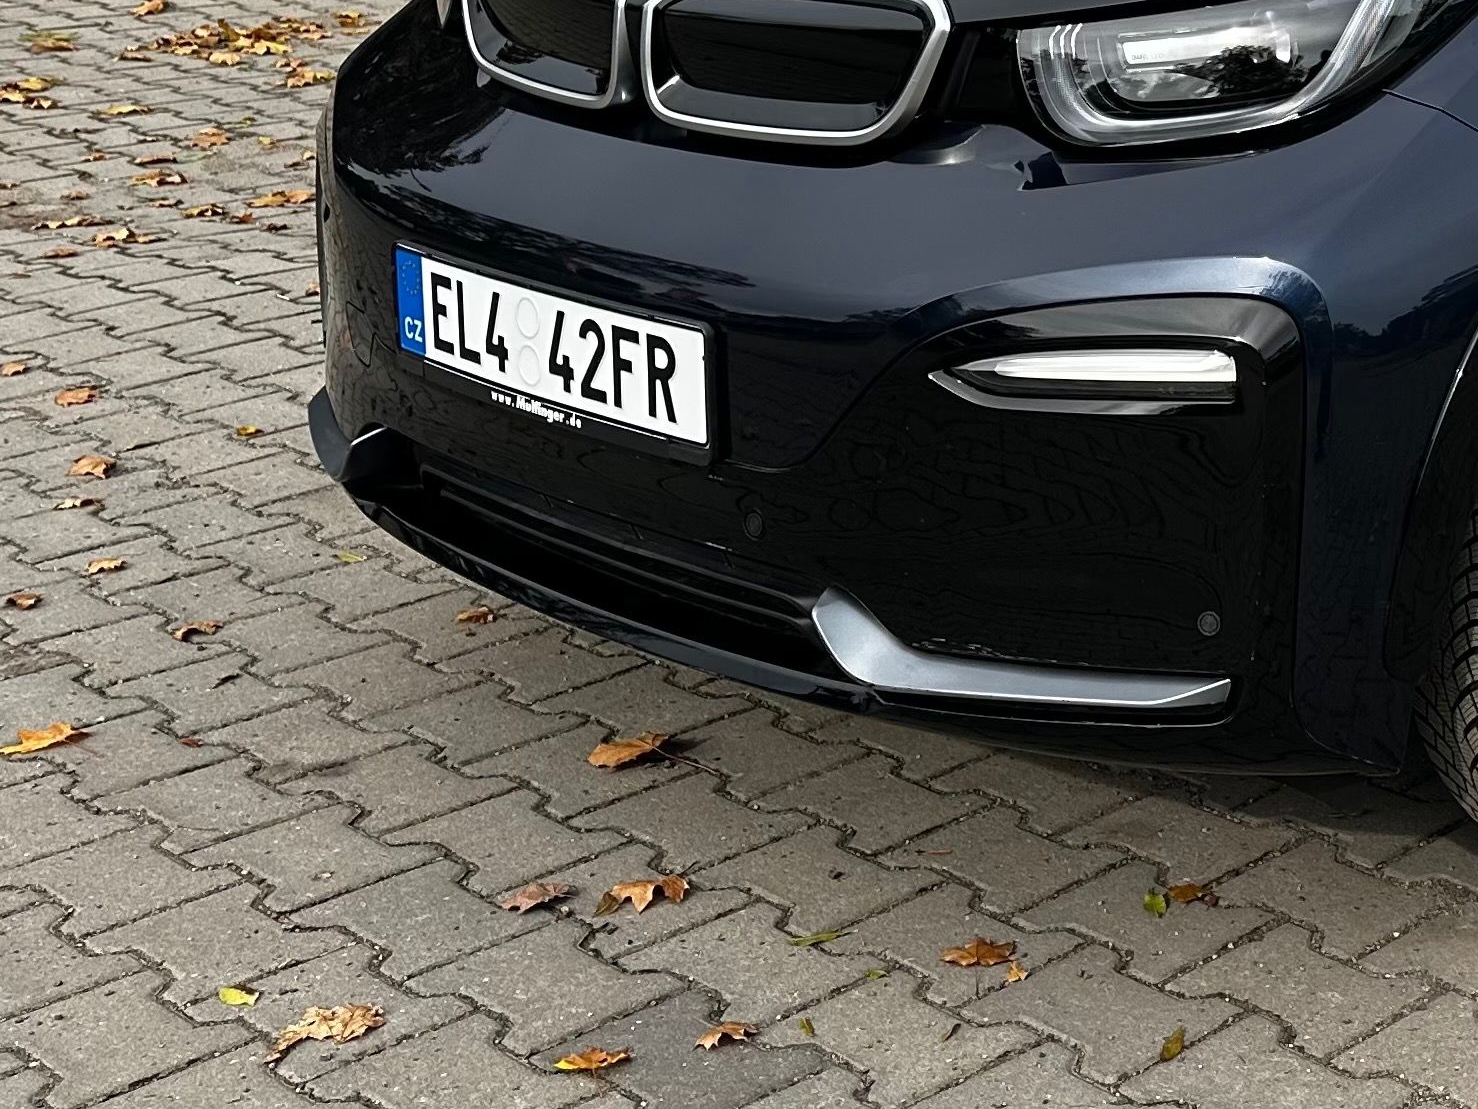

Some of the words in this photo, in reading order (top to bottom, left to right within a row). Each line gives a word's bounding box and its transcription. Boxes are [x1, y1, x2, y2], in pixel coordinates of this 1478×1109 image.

[404, 316, 423, 343] CZ
[430, 272, 509, 374] EL4
[549, 310, 678, 425] 42FR
